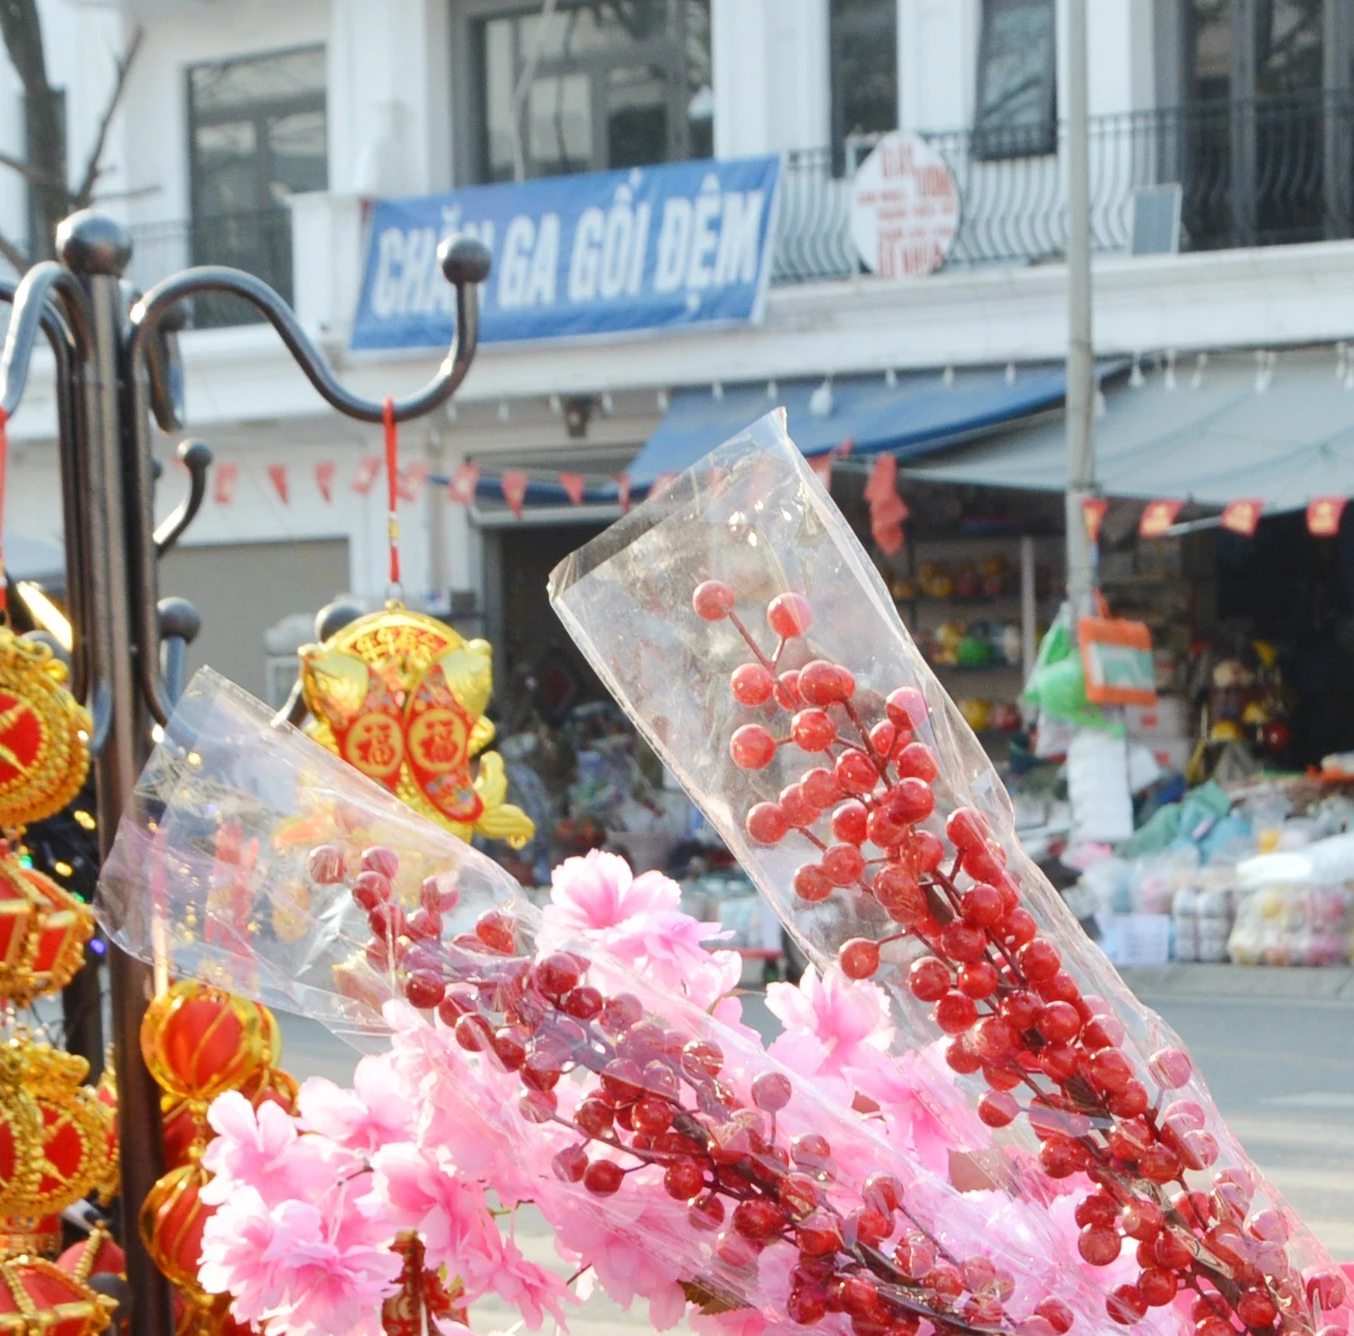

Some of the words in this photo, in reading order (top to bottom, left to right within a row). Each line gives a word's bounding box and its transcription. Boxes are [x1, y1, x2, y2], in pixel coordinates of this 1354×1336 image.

[498, 212, 561, 310] GA
[568, 167, 652, 303] GỐI
[654, 171, 765, 312] ĐỆM
